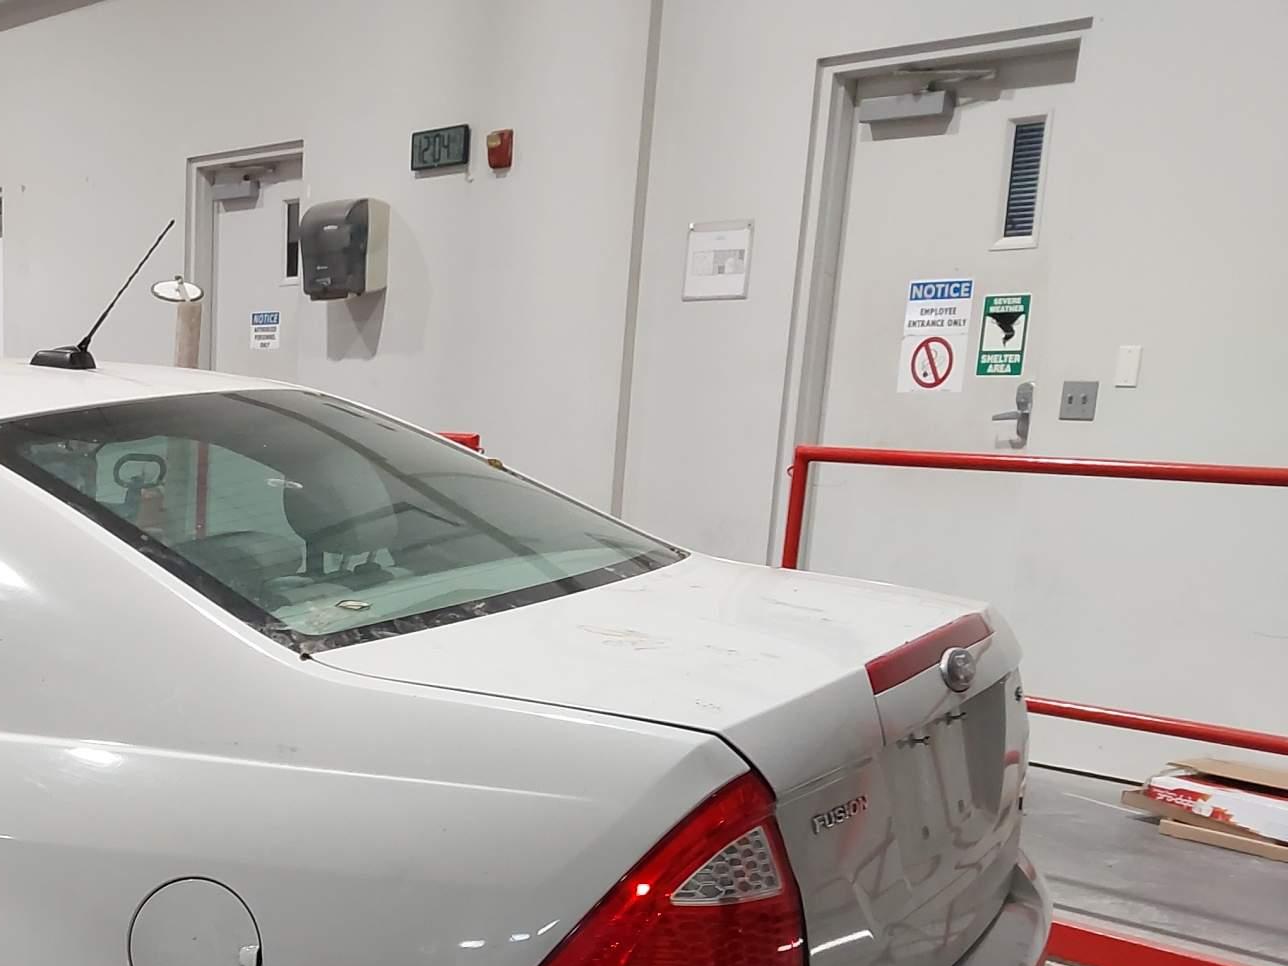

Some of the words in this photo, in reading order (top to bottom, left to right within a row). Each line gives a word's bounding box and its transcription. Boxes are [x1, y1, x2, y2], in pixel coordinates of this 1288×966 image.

[912, 282, 971, 299] NOTICE
[920, 306, 957, 316] EMPLOYEE
[253, 313, 279, 324] NOTICE
[907, 319, 945, 328] ENTRANCE
[947, 319, 967, 327] ONLY
[980, 353, 1021, 364] SHELTER
[986, 363, 1012, 373] AREA
[812, 795, 868, 834] FUSION
